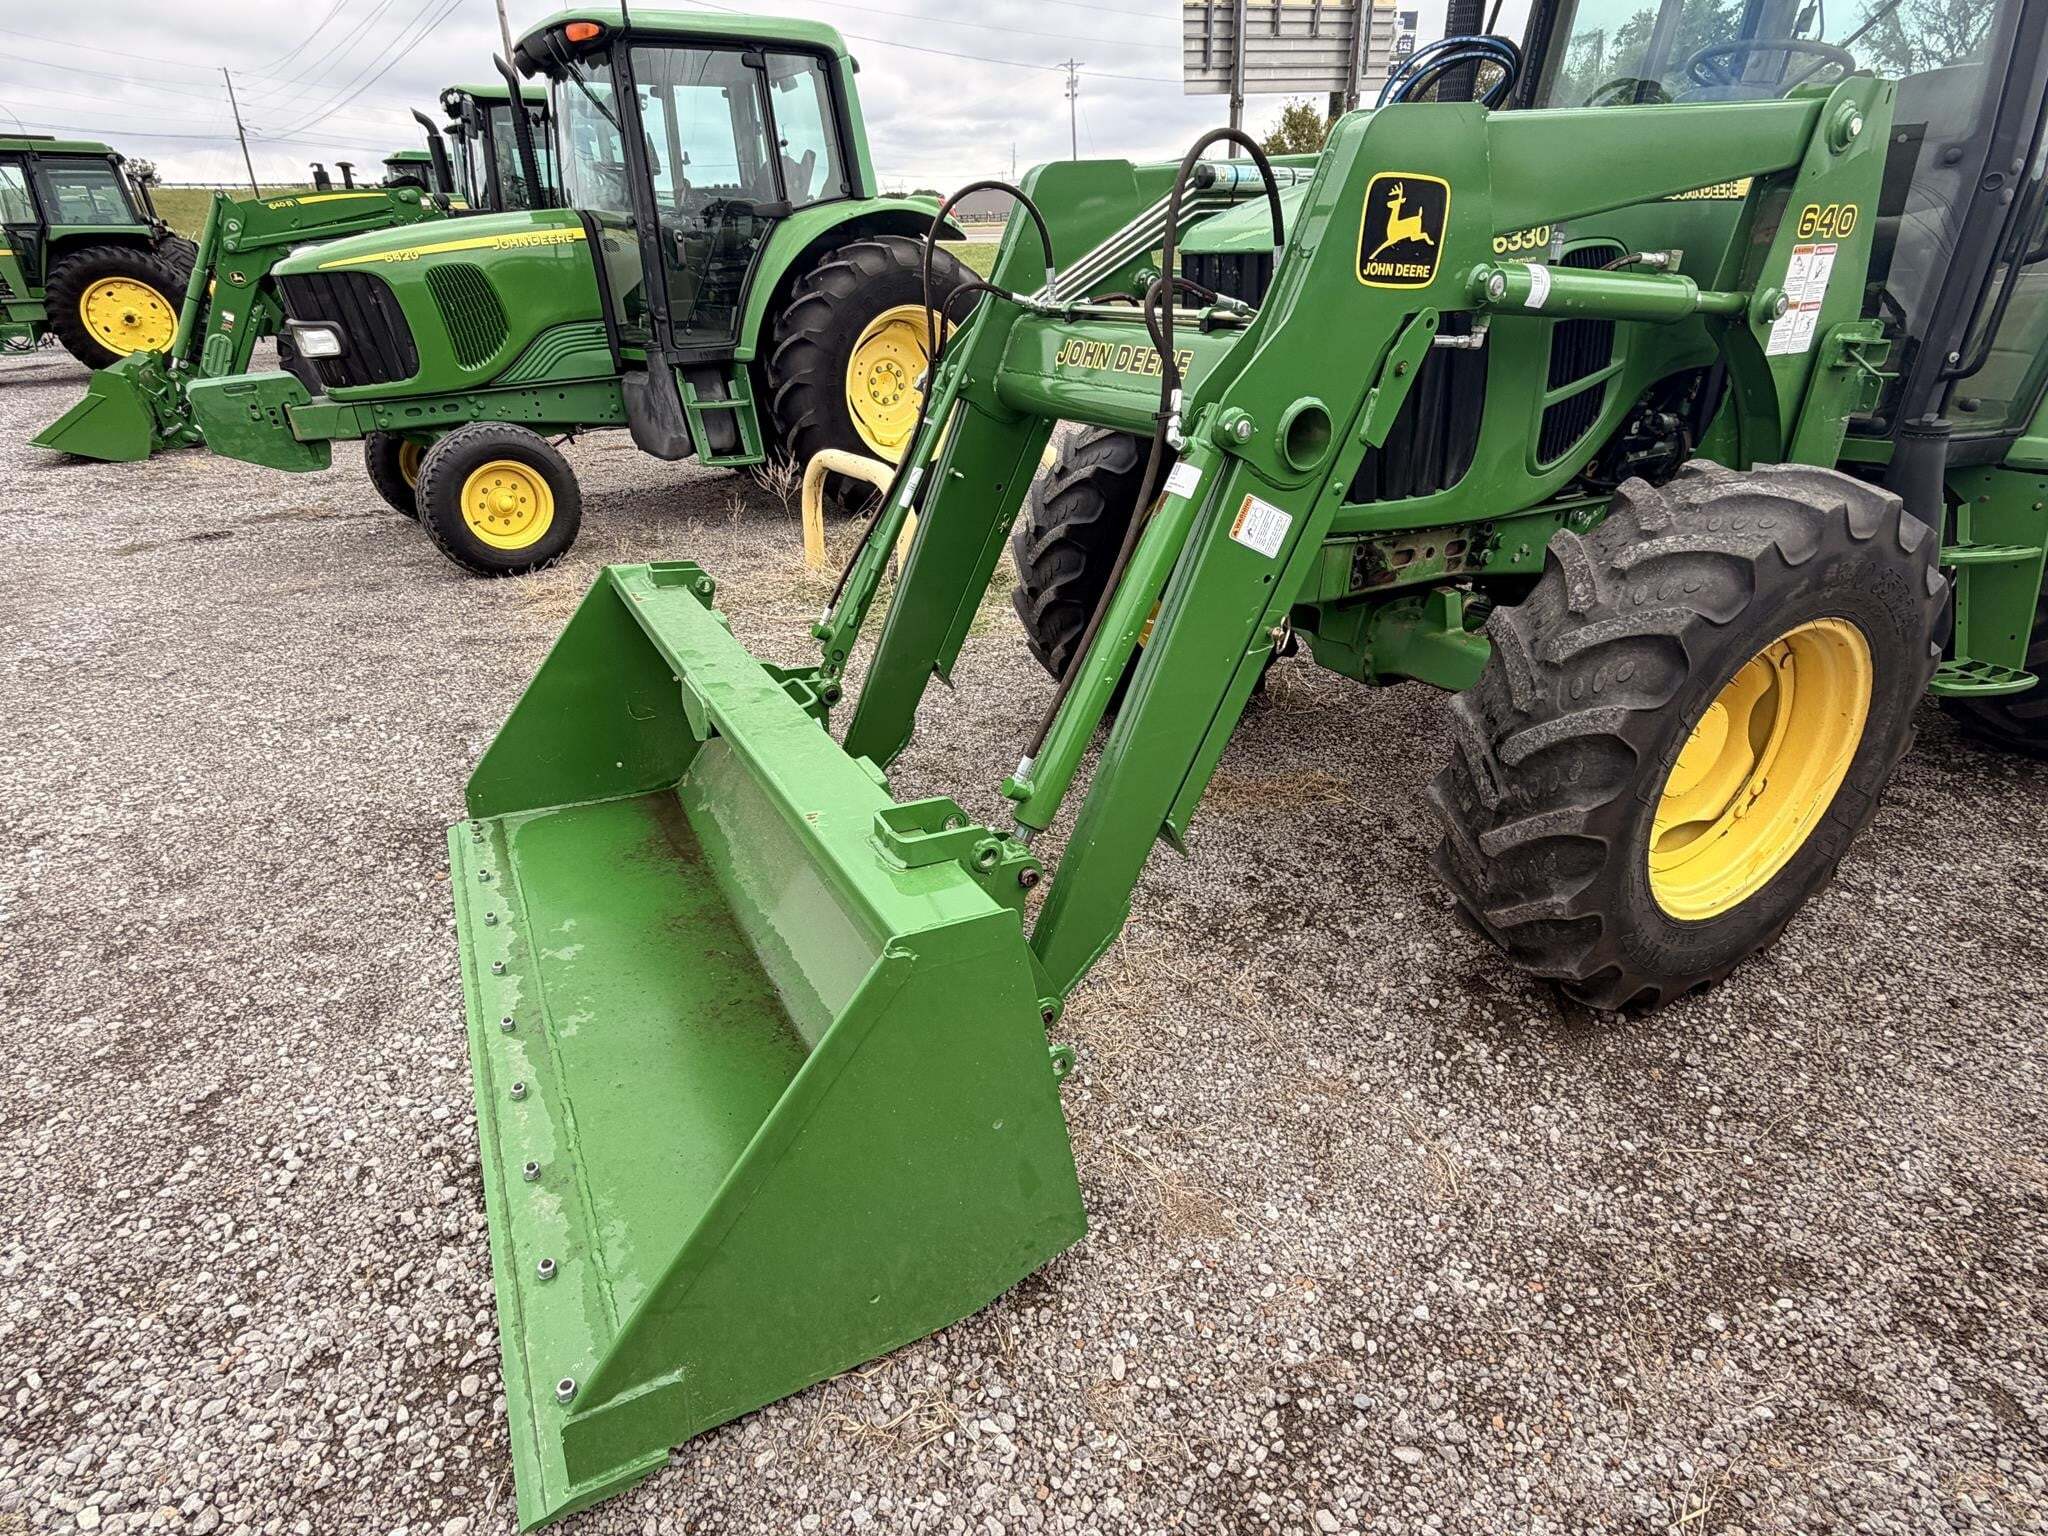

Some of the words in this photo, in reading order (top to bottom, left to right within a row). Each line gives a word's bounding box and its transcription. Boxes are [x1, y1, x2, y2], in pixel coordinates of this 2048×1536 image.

[1797, 204, 1858, 238] 640
[1493, 225, 1550, 254] 6330
[1363, 262, 1394, 276] JOHN
[1395, 263, 1431, 278] DEERE
[1056, 339, 1114, 370] JOHN
